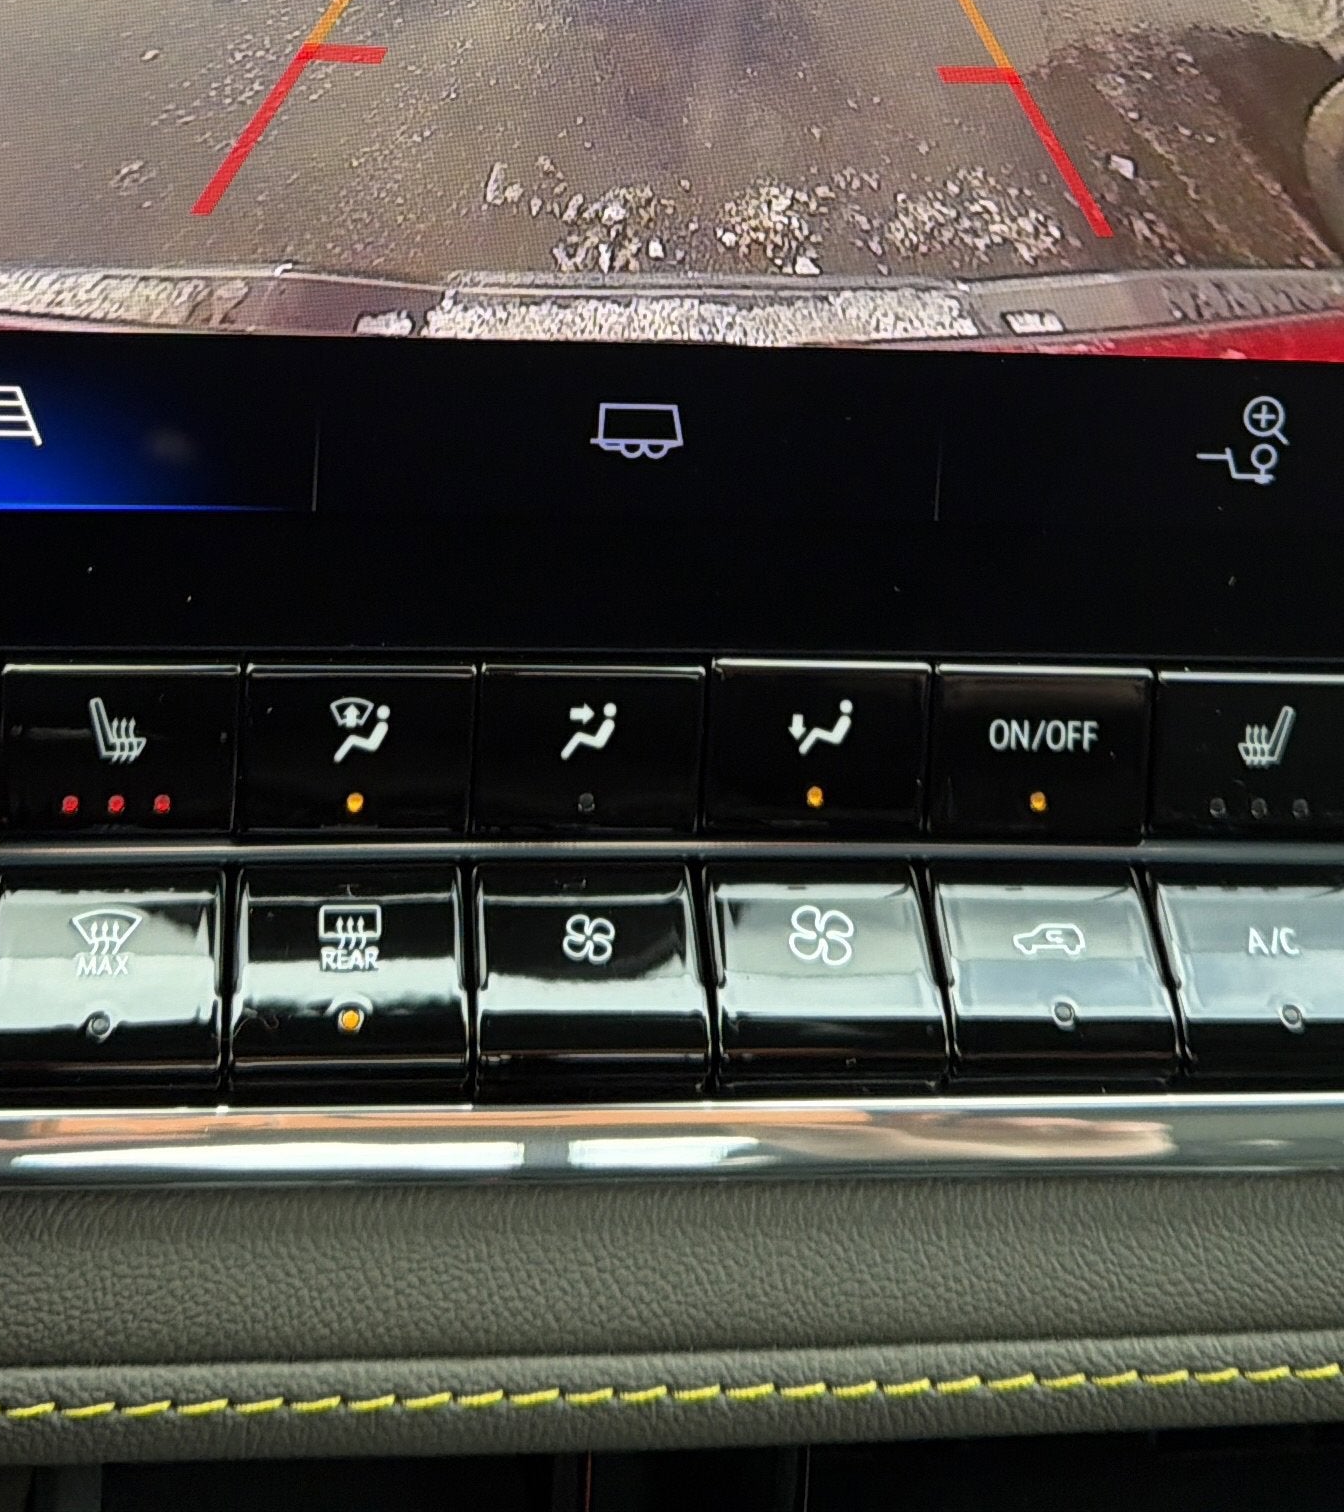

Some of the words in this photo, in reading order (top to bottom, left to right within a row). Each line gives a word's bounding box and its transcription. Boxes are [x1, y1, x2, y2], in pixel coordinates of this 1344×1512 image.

[988, 718, 1100, 752] ON/OFF
[1247, 925, 1301, 955] A/C
[76, 953, 129, 977] MAX
[321, 947, 380, 971] REAR
